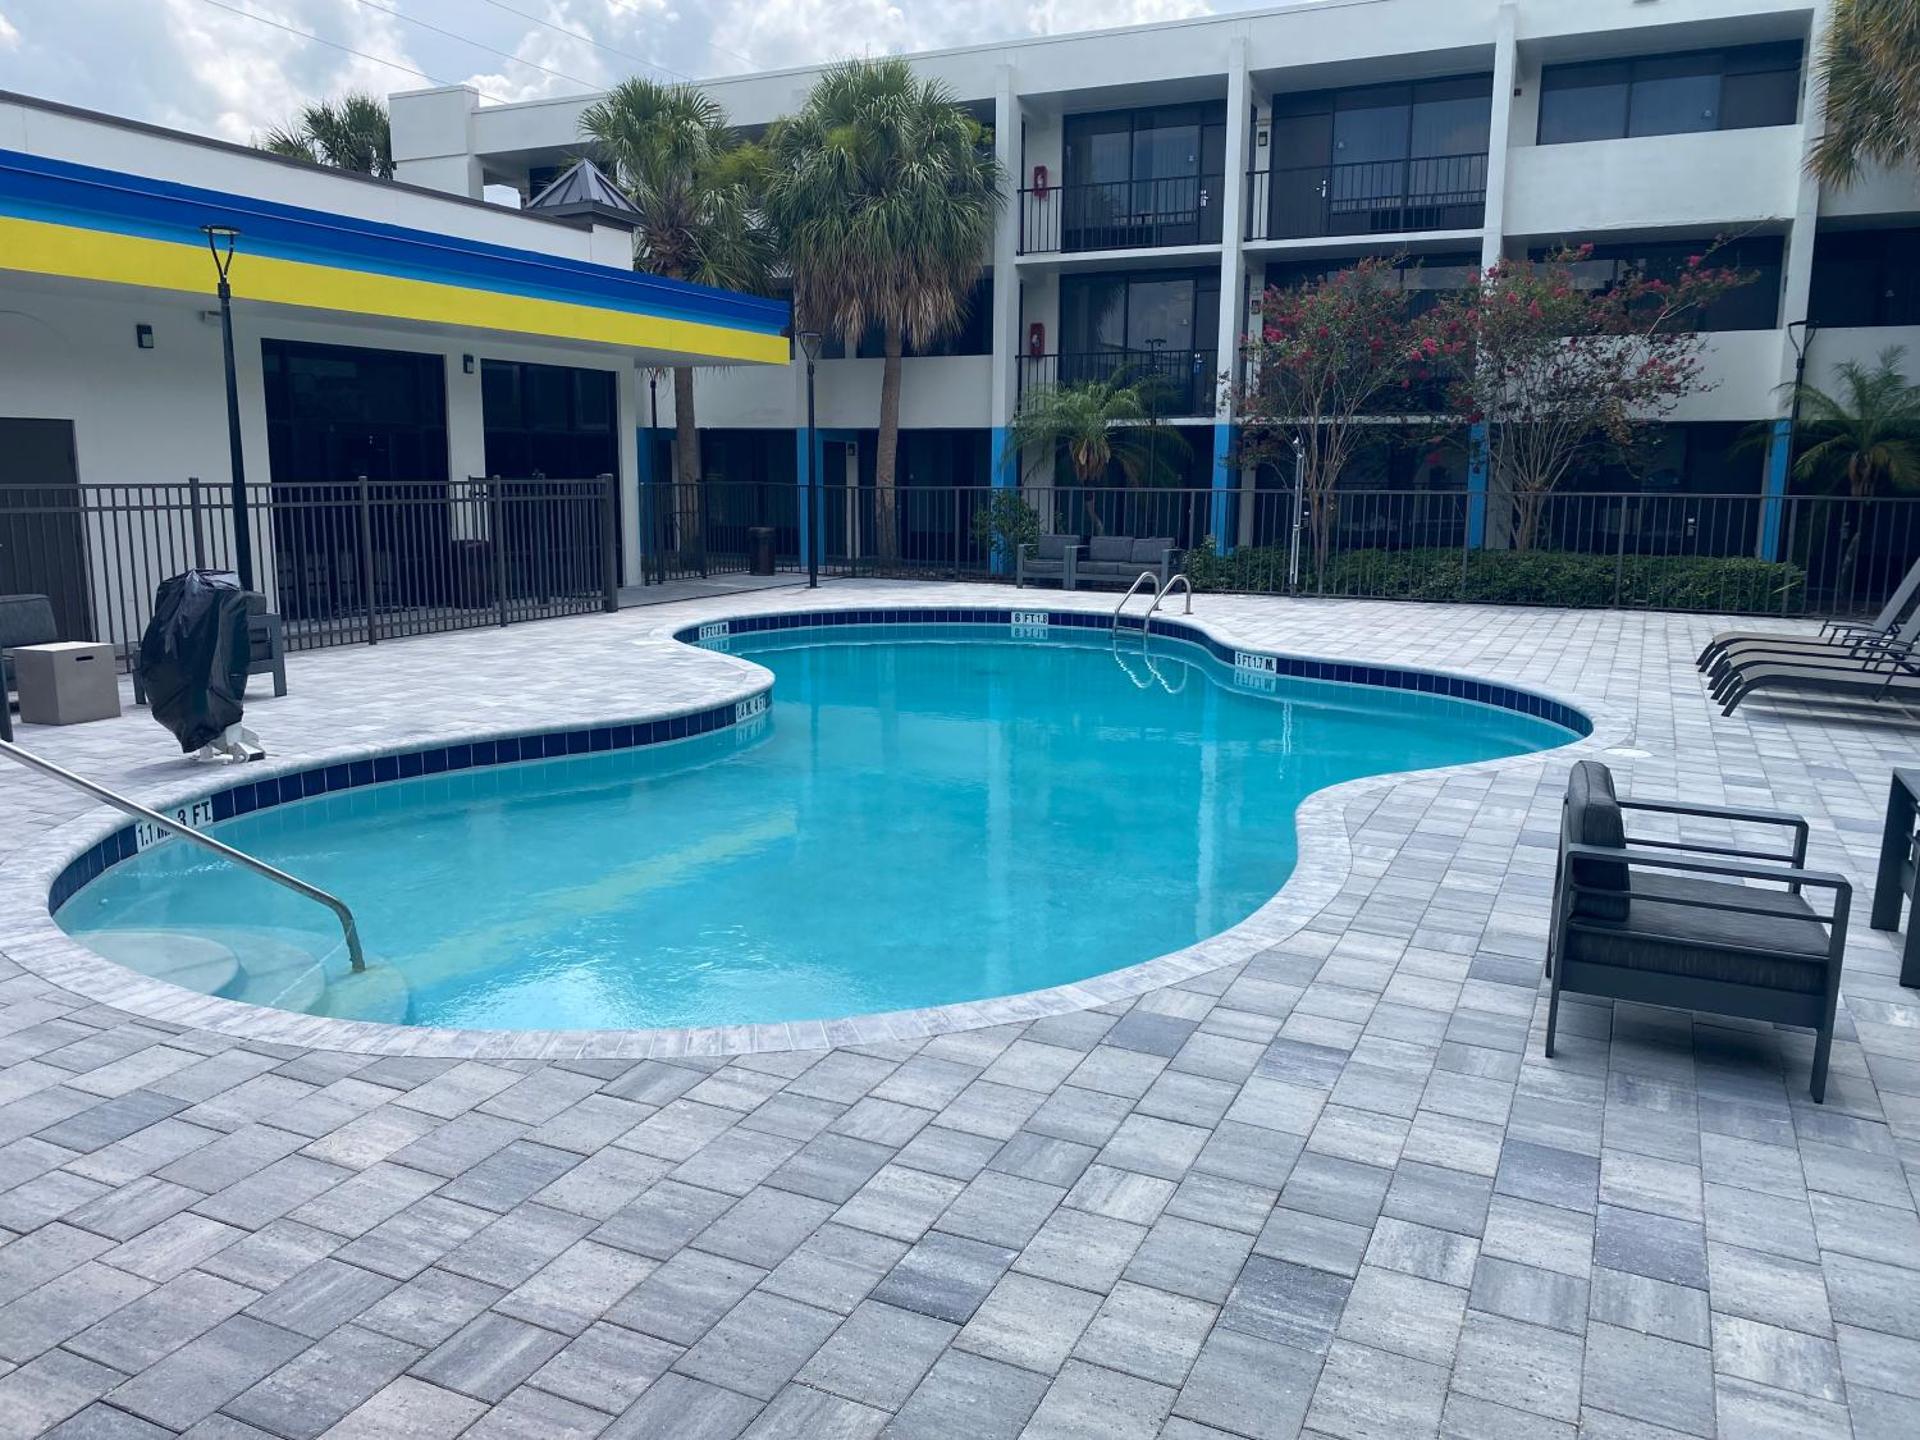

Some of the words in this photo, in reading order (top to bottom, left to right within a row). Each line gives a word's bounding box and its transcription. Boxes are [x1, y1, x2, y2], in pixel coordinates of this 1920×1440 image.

[1014, 612, 1021, 623] 6
[138, 823, 153, 847] 1.1
[178, 809, 187, 826] 3
[192, 800, 211, 826] FT.
